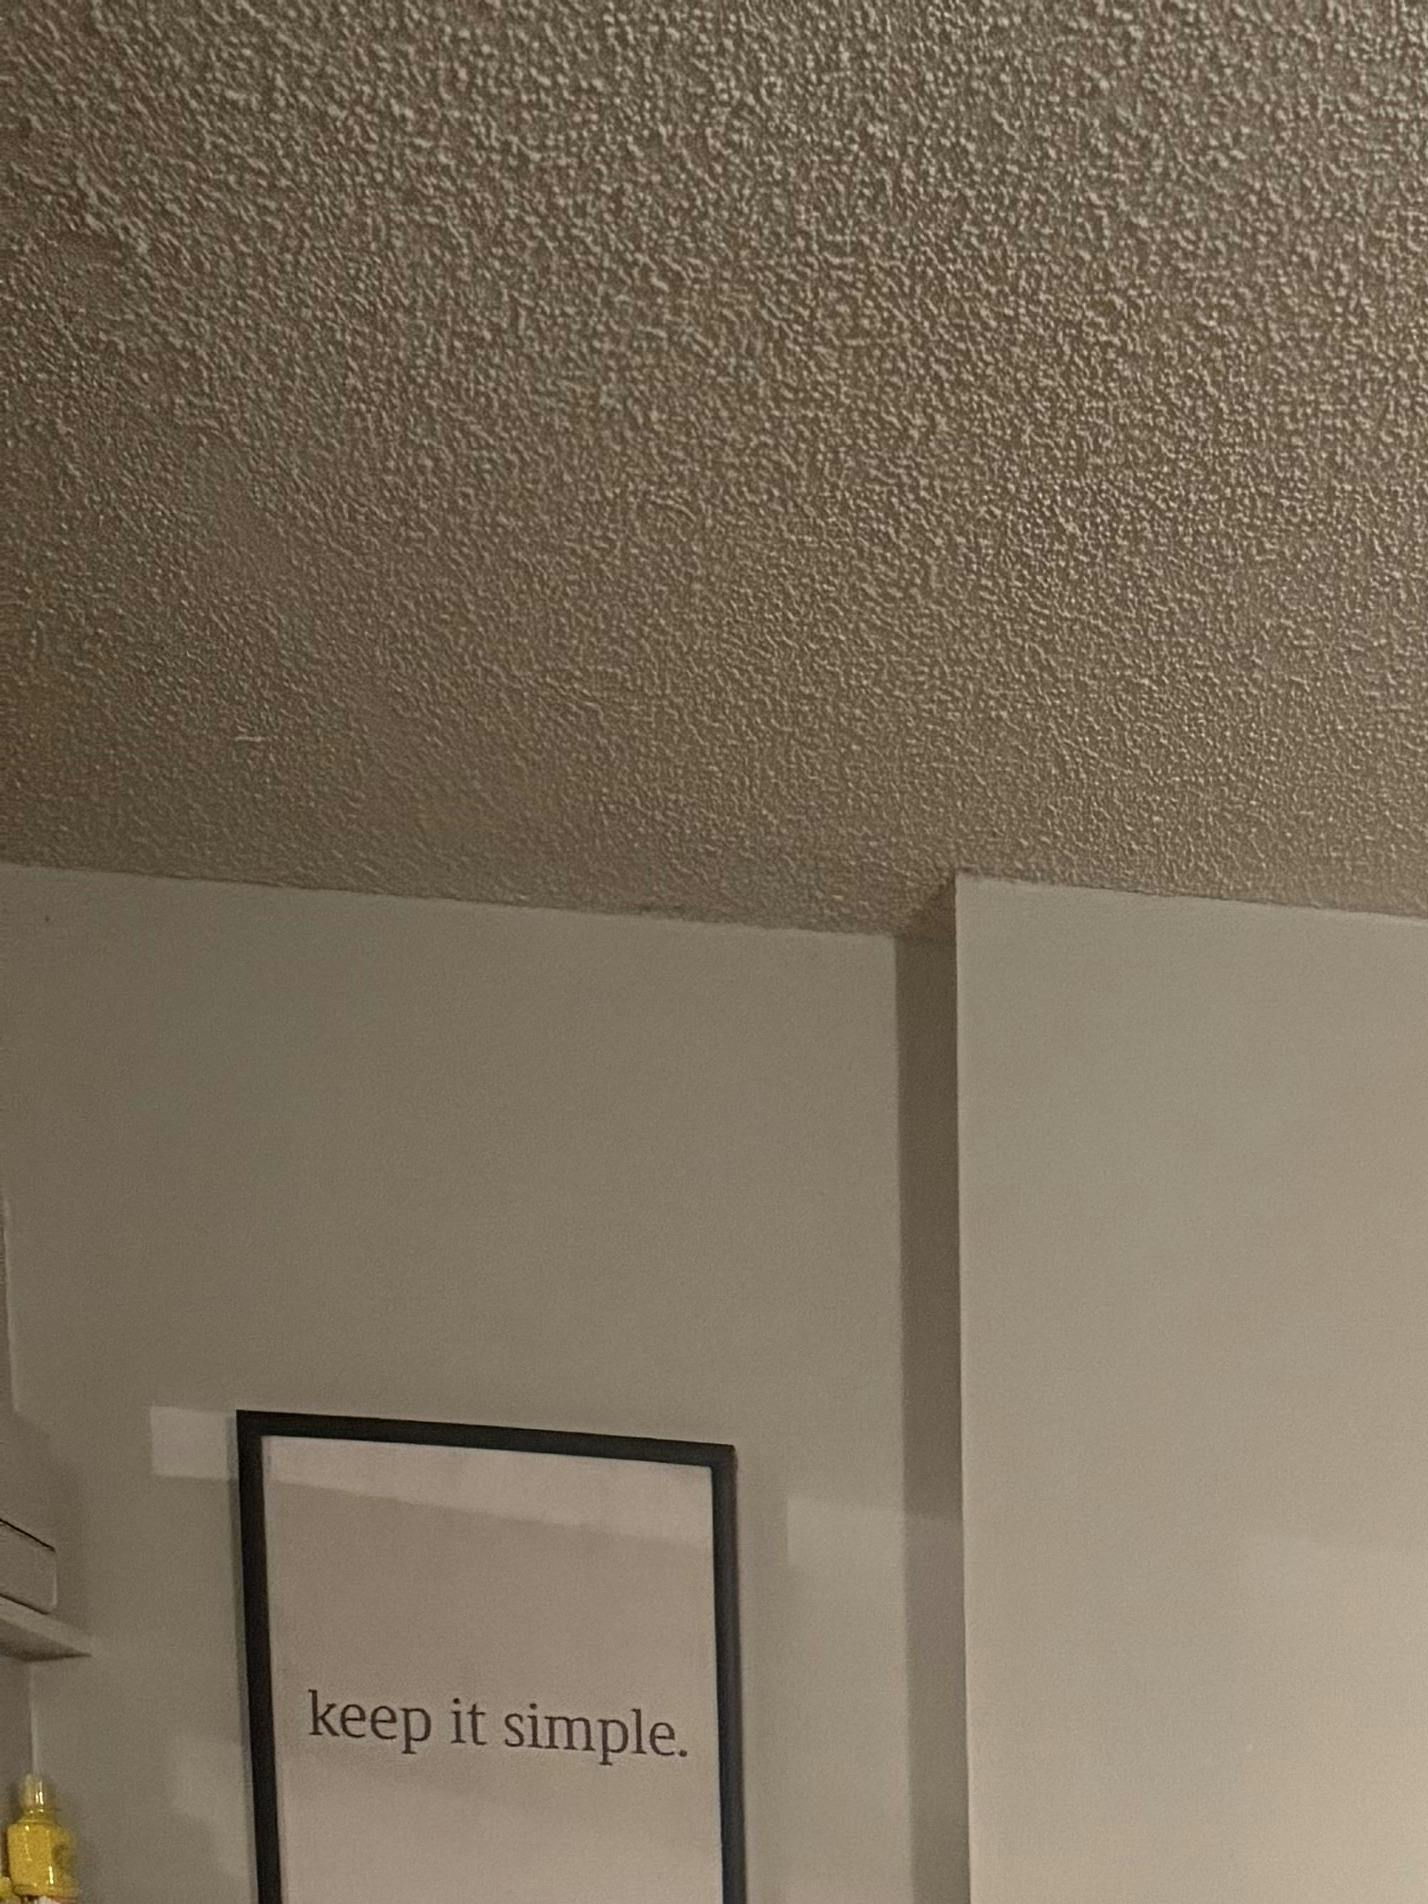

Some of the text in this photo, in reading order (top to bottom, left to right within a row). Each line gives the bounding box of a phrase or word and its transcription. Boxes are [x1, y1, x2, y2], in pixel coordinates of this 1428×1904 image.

[307, 1689, 689, 1767] keep it simple.
